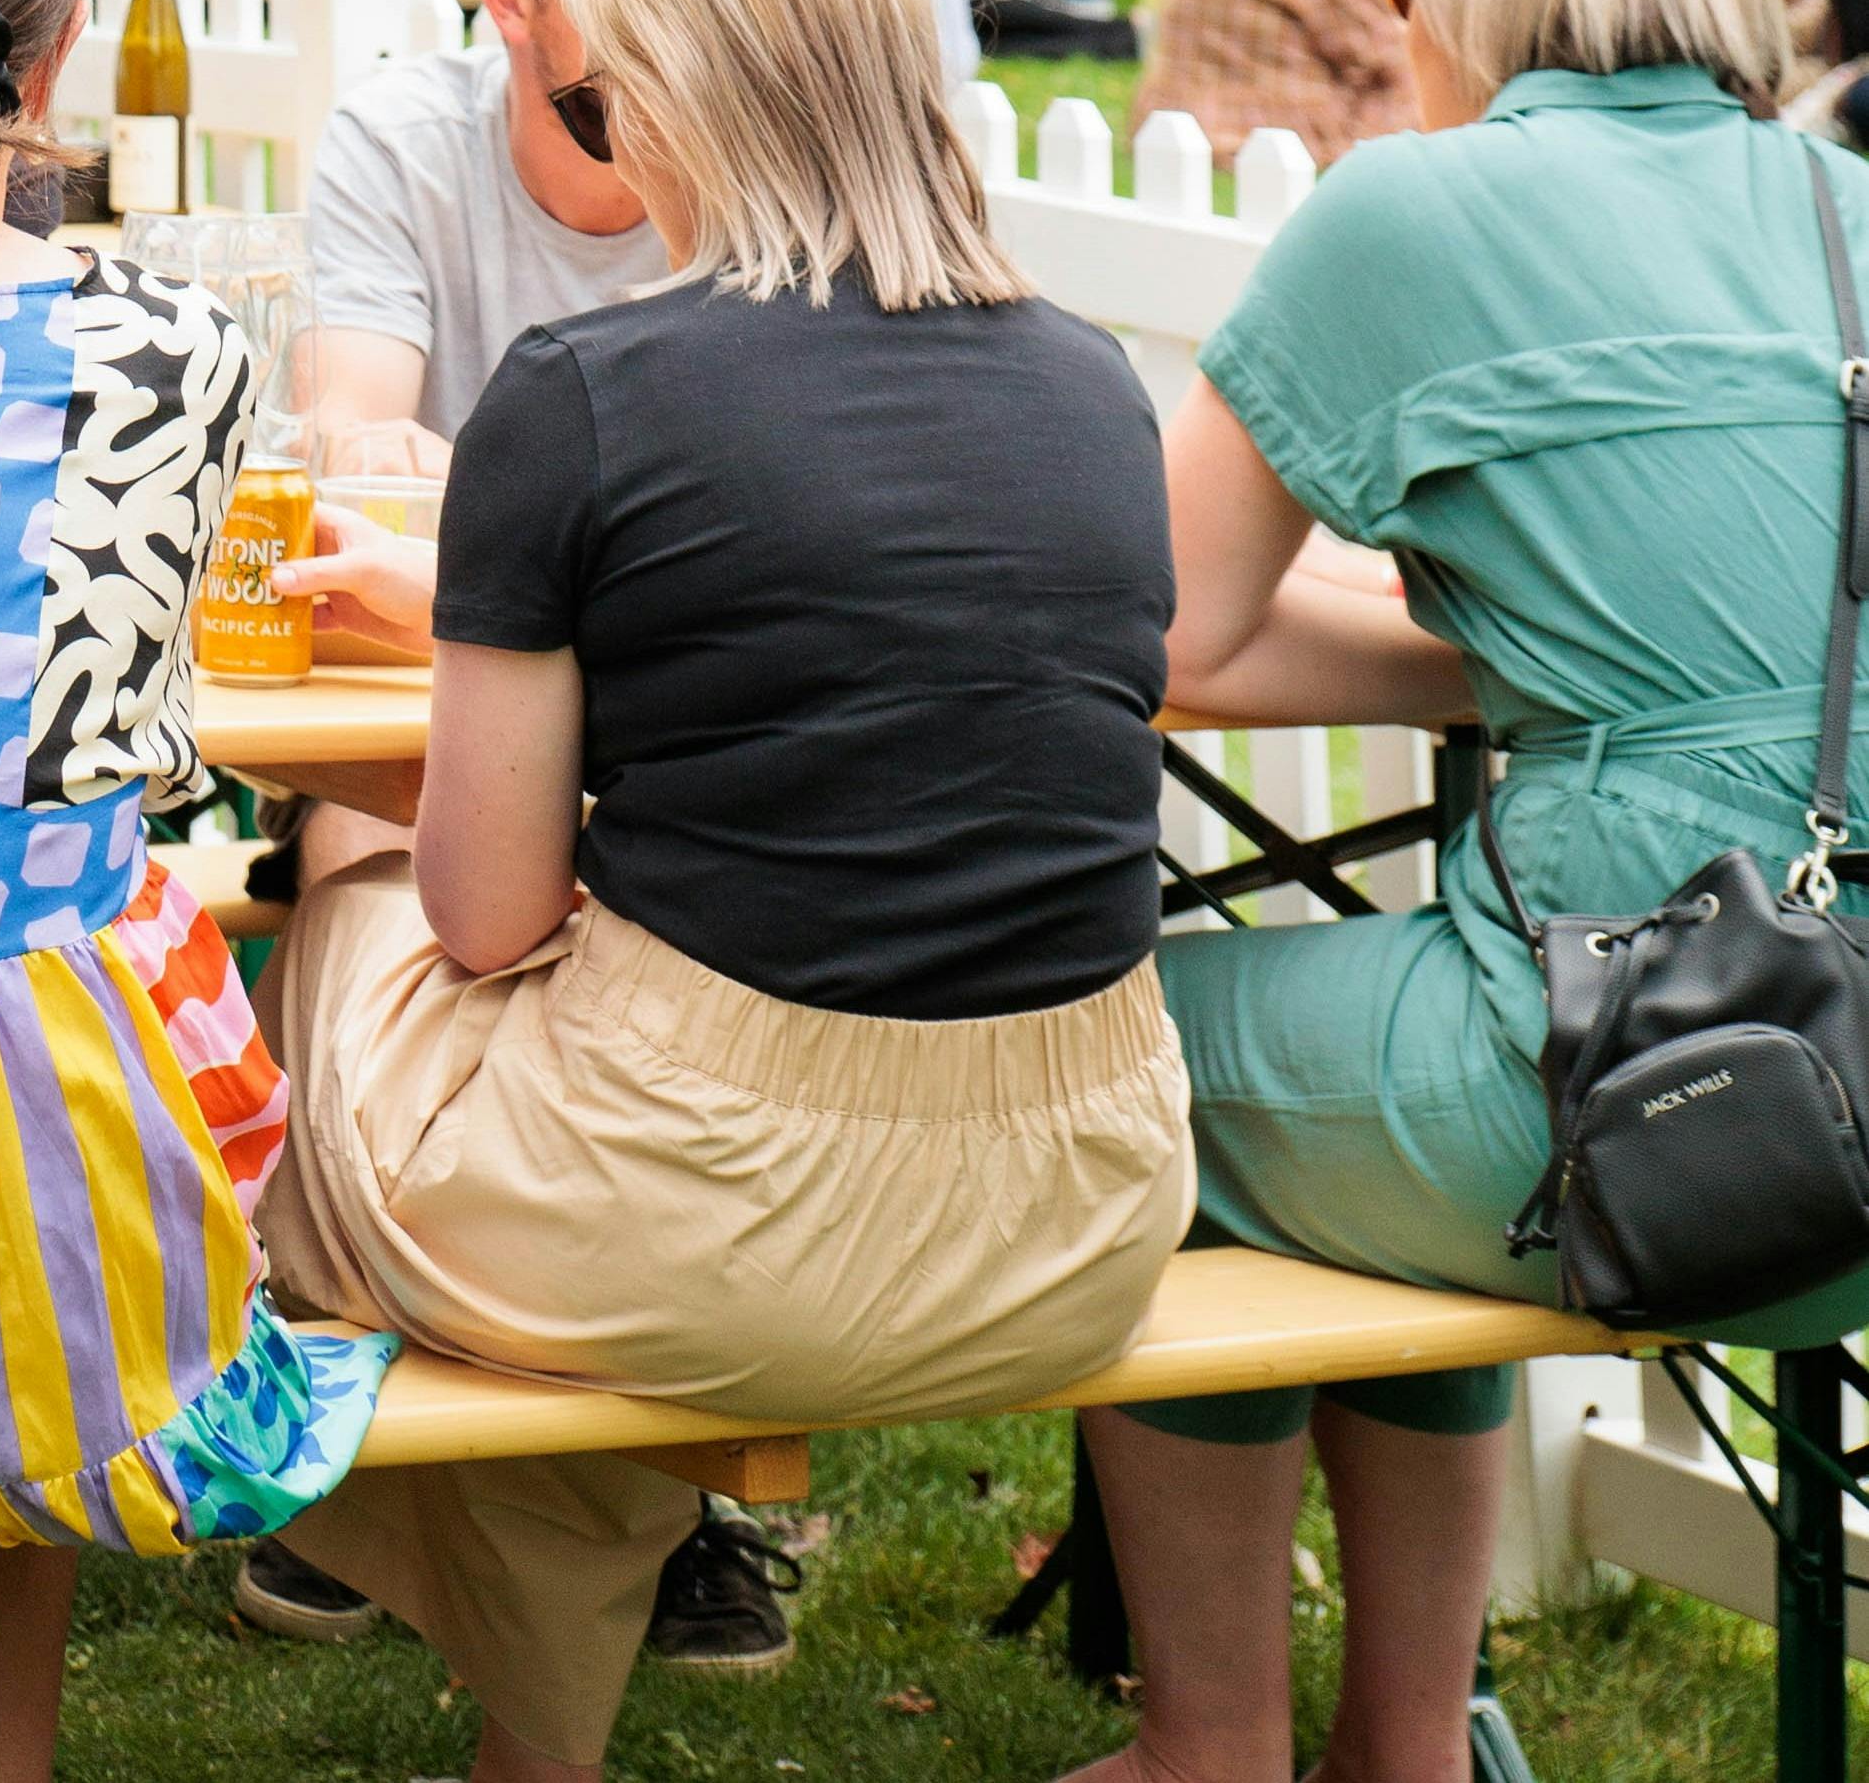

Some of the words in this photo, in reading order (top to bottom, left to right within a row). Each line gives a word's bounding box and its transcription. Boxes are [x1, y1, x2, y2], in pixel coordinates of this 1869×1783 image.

[259, 621, 293, 638] ALE
[1642, 1088, 1688, 1118] JACK
[1683, 1068, 1734, 1099] WILLS
